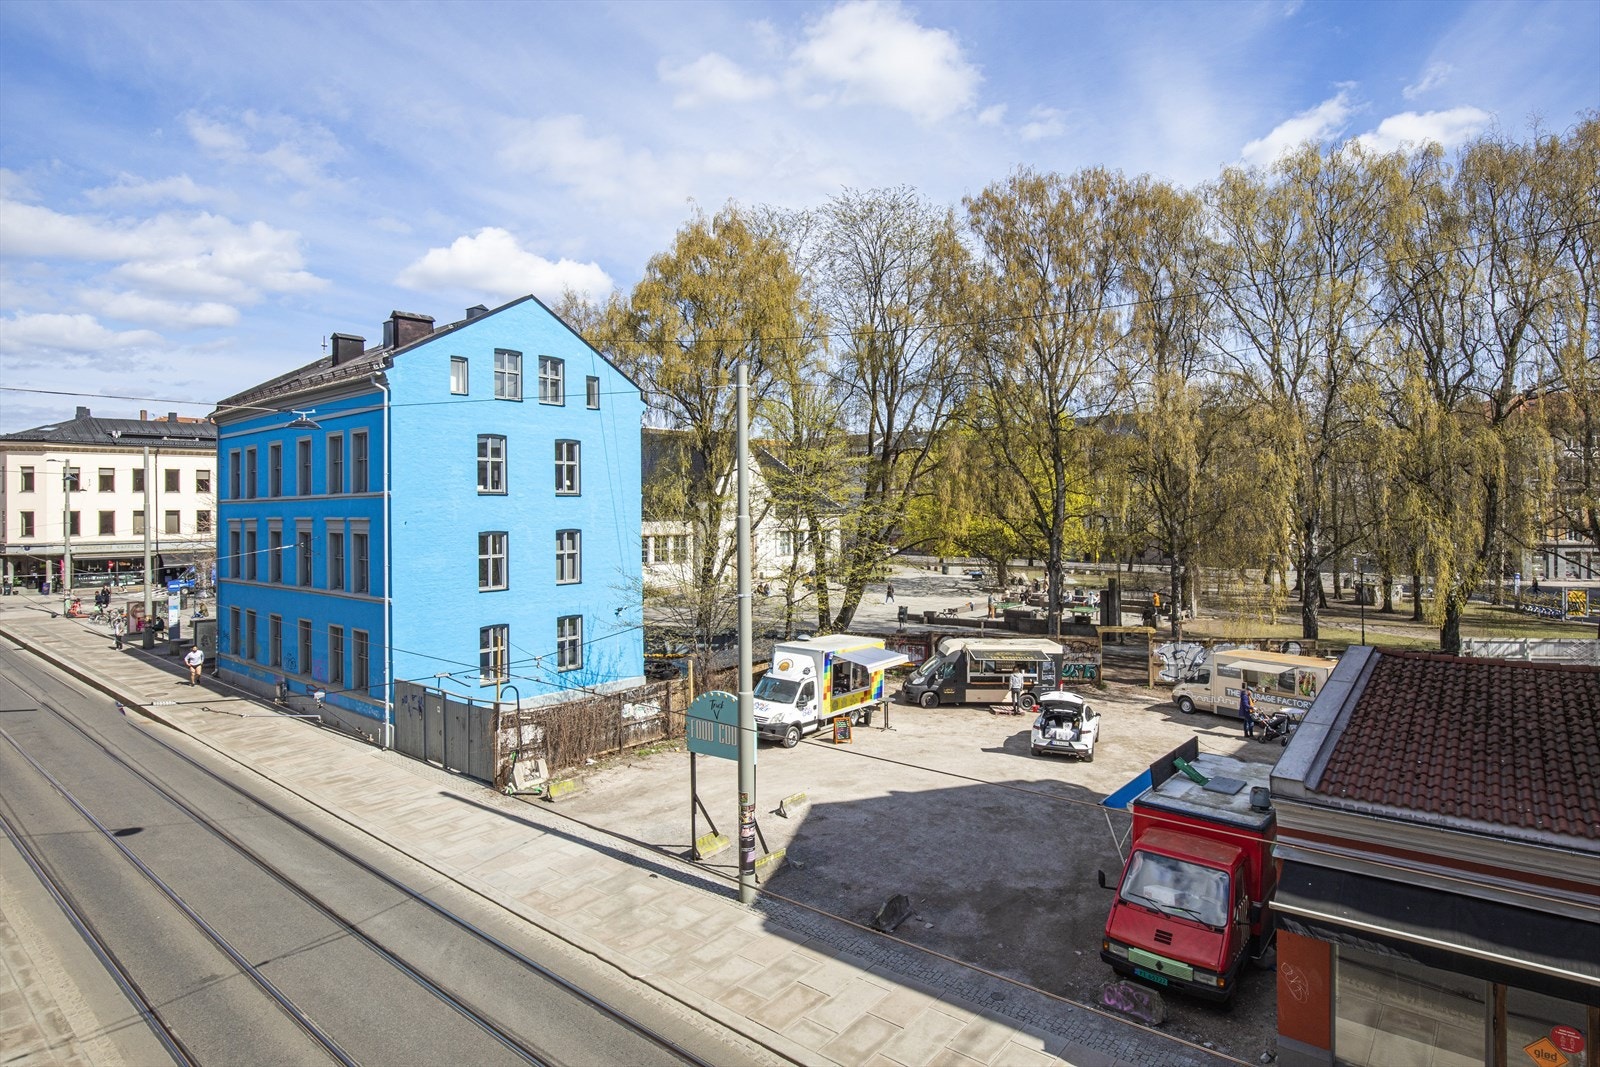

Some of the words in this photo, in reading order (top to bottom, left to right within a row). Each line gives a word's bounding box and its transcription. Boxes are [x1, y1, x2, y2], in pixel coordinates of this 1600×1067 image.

[1226, 688, 1241, 698] THE
[1251, 691, 1276, 703] USAGE
[691, 719, 714, 742] FOOD
[719, 723, 737, 746] COU
[1533, 1049, 1558, 1062] glød
